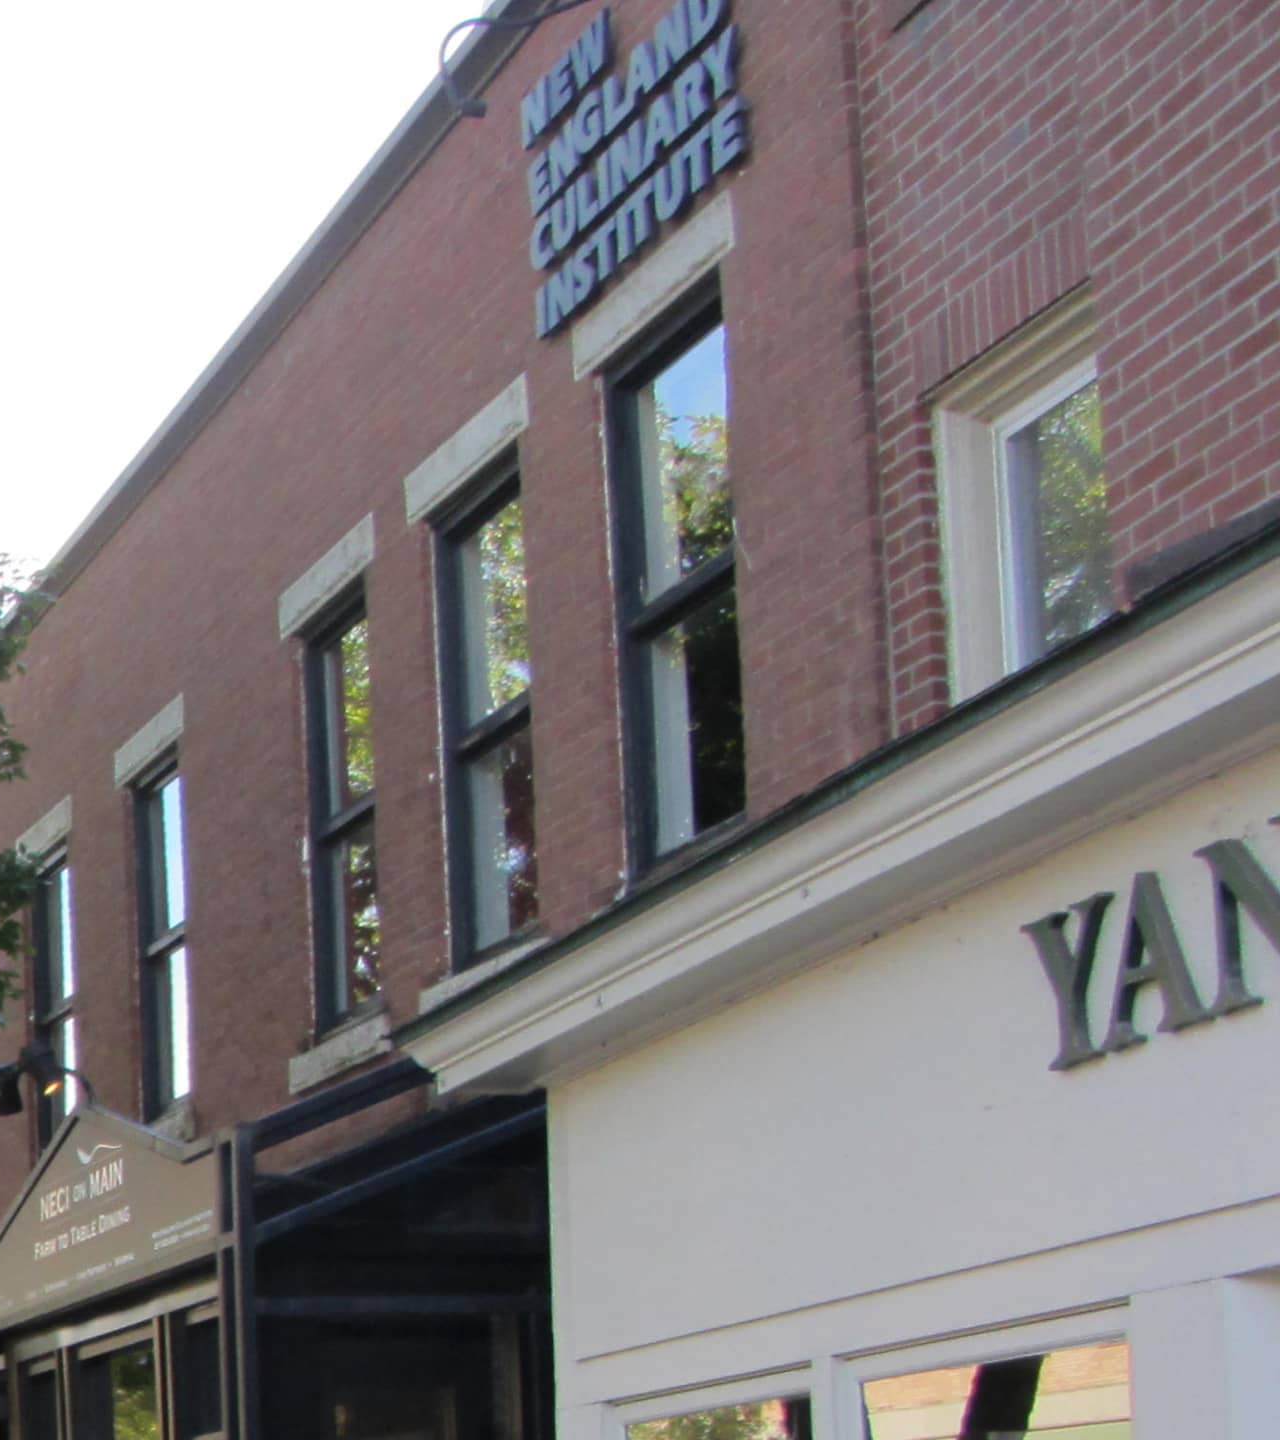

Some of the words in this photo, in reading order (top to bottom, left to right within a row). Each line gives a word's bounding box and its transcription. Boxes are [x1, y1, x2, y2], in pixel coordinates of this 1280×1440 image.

[521, 6, 612, 150] NEW
[528, 0, 729, 217] ENGLAND
[530, 23, 739, 270] CULINARY
[536, 95, 748, 339] INSTITUTE
[40, 1186, 69, 1222] NECI
[89, 1159, 124, 1199] MAIN
